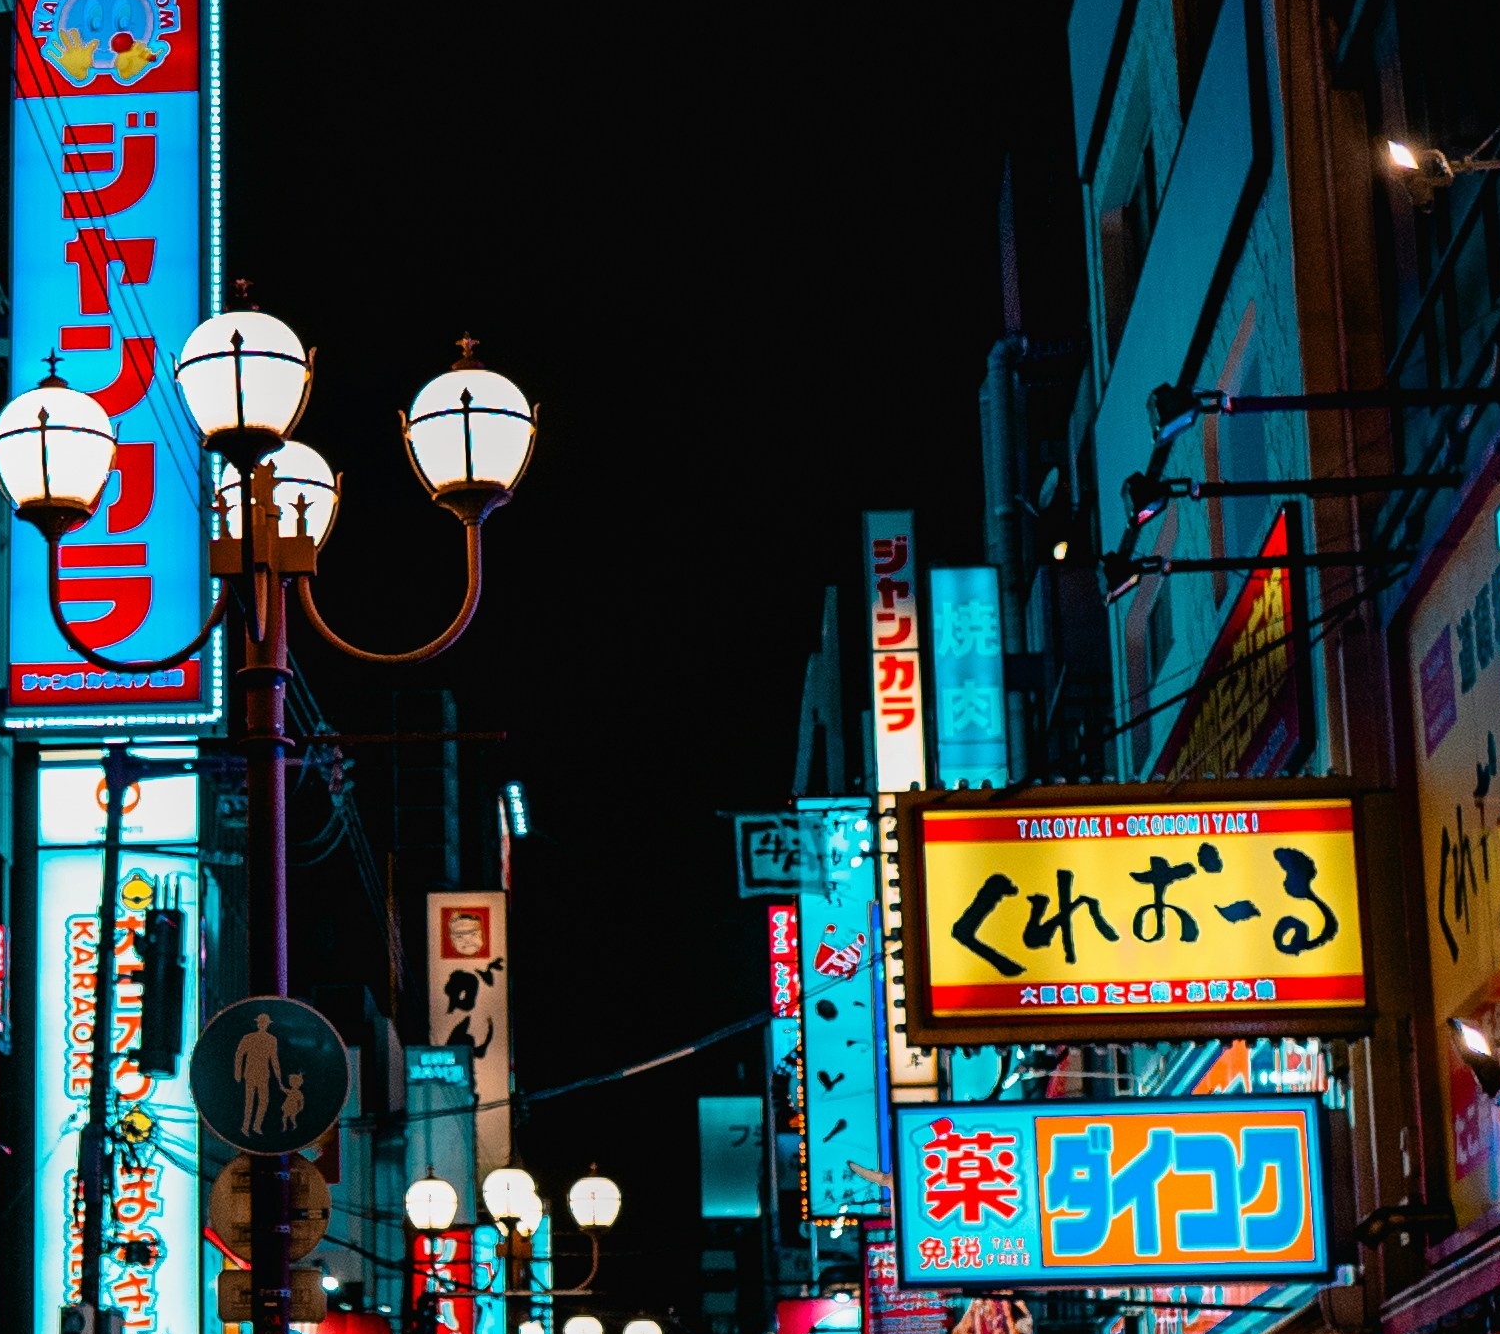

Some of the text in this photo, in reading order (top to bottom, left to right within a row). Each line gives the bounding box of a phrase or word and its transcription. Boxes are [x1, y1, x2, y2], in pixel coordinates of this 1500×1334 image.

[871, 534, 917, 733] ジャンカラ
[935, 601, 1000, 738] 焼肉
[71, 921, 98, 1094] KARAOKE
[918, 1236, 983, 1270] 免税
[922, 1117, 1307, 1257] 薬 ダイコク
